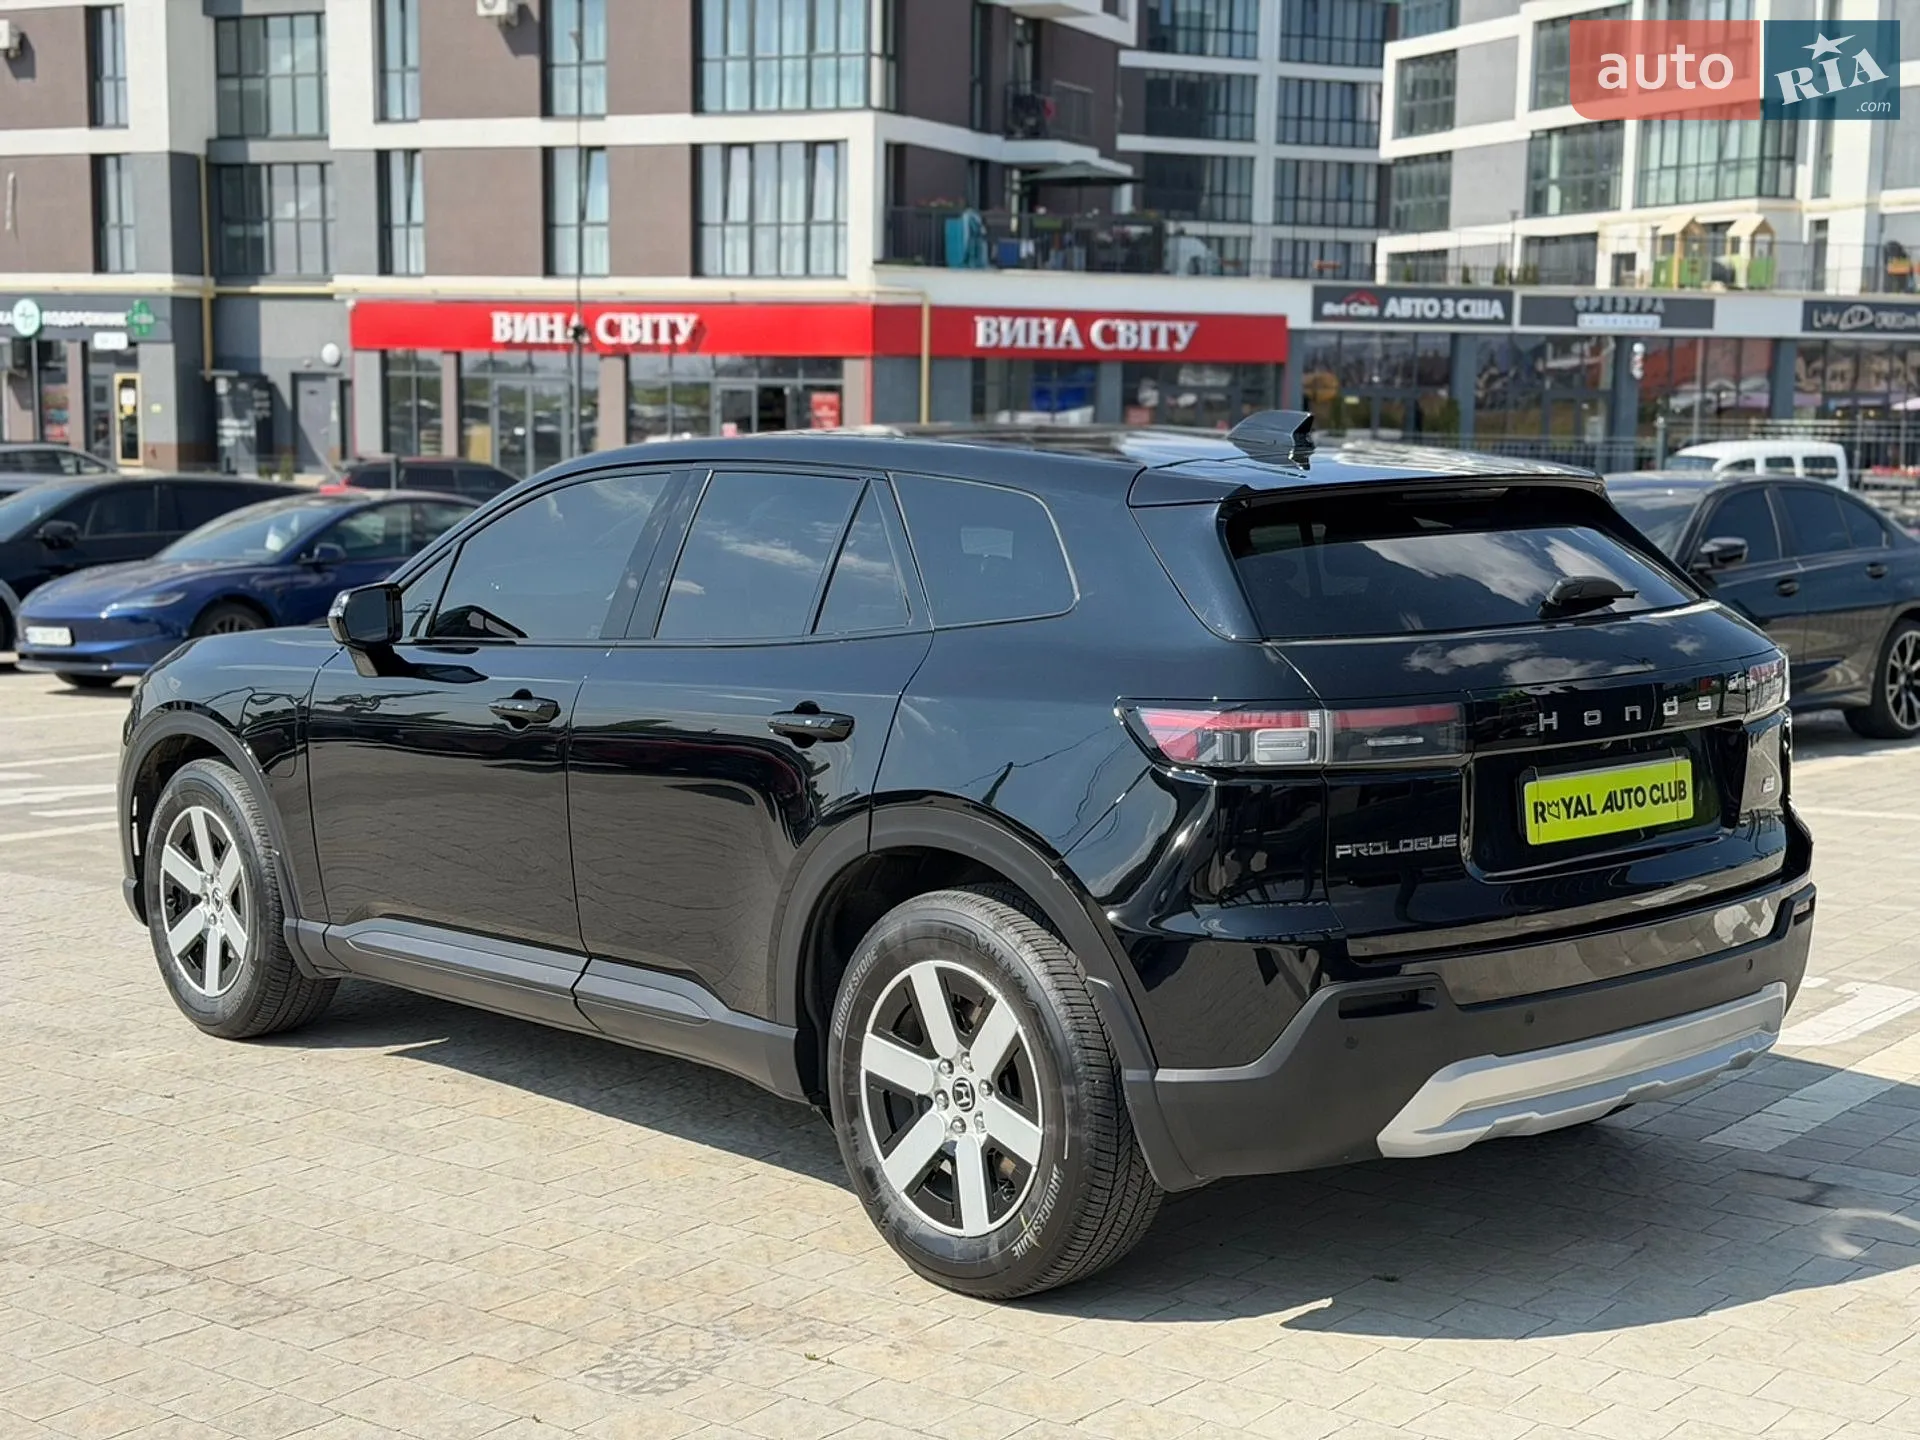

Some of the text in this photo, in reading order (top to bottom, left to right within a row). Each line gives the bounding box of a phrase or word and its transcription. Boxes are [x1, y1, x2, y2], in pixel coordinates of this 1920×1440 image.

[1384, 297, 1440, 318] АВТО
[1456, 298, 1505, 320] США
[490, 311, 699, 345] ВИНА СВІТУ
[974, 316, 1199, 351] ВИНА СВІТУ
[1601, 785, 1647, 815] AUTO
[1649, 779, 1688, 806] CLUB
[1334, 834, 1458, 859] PROLOGUE
